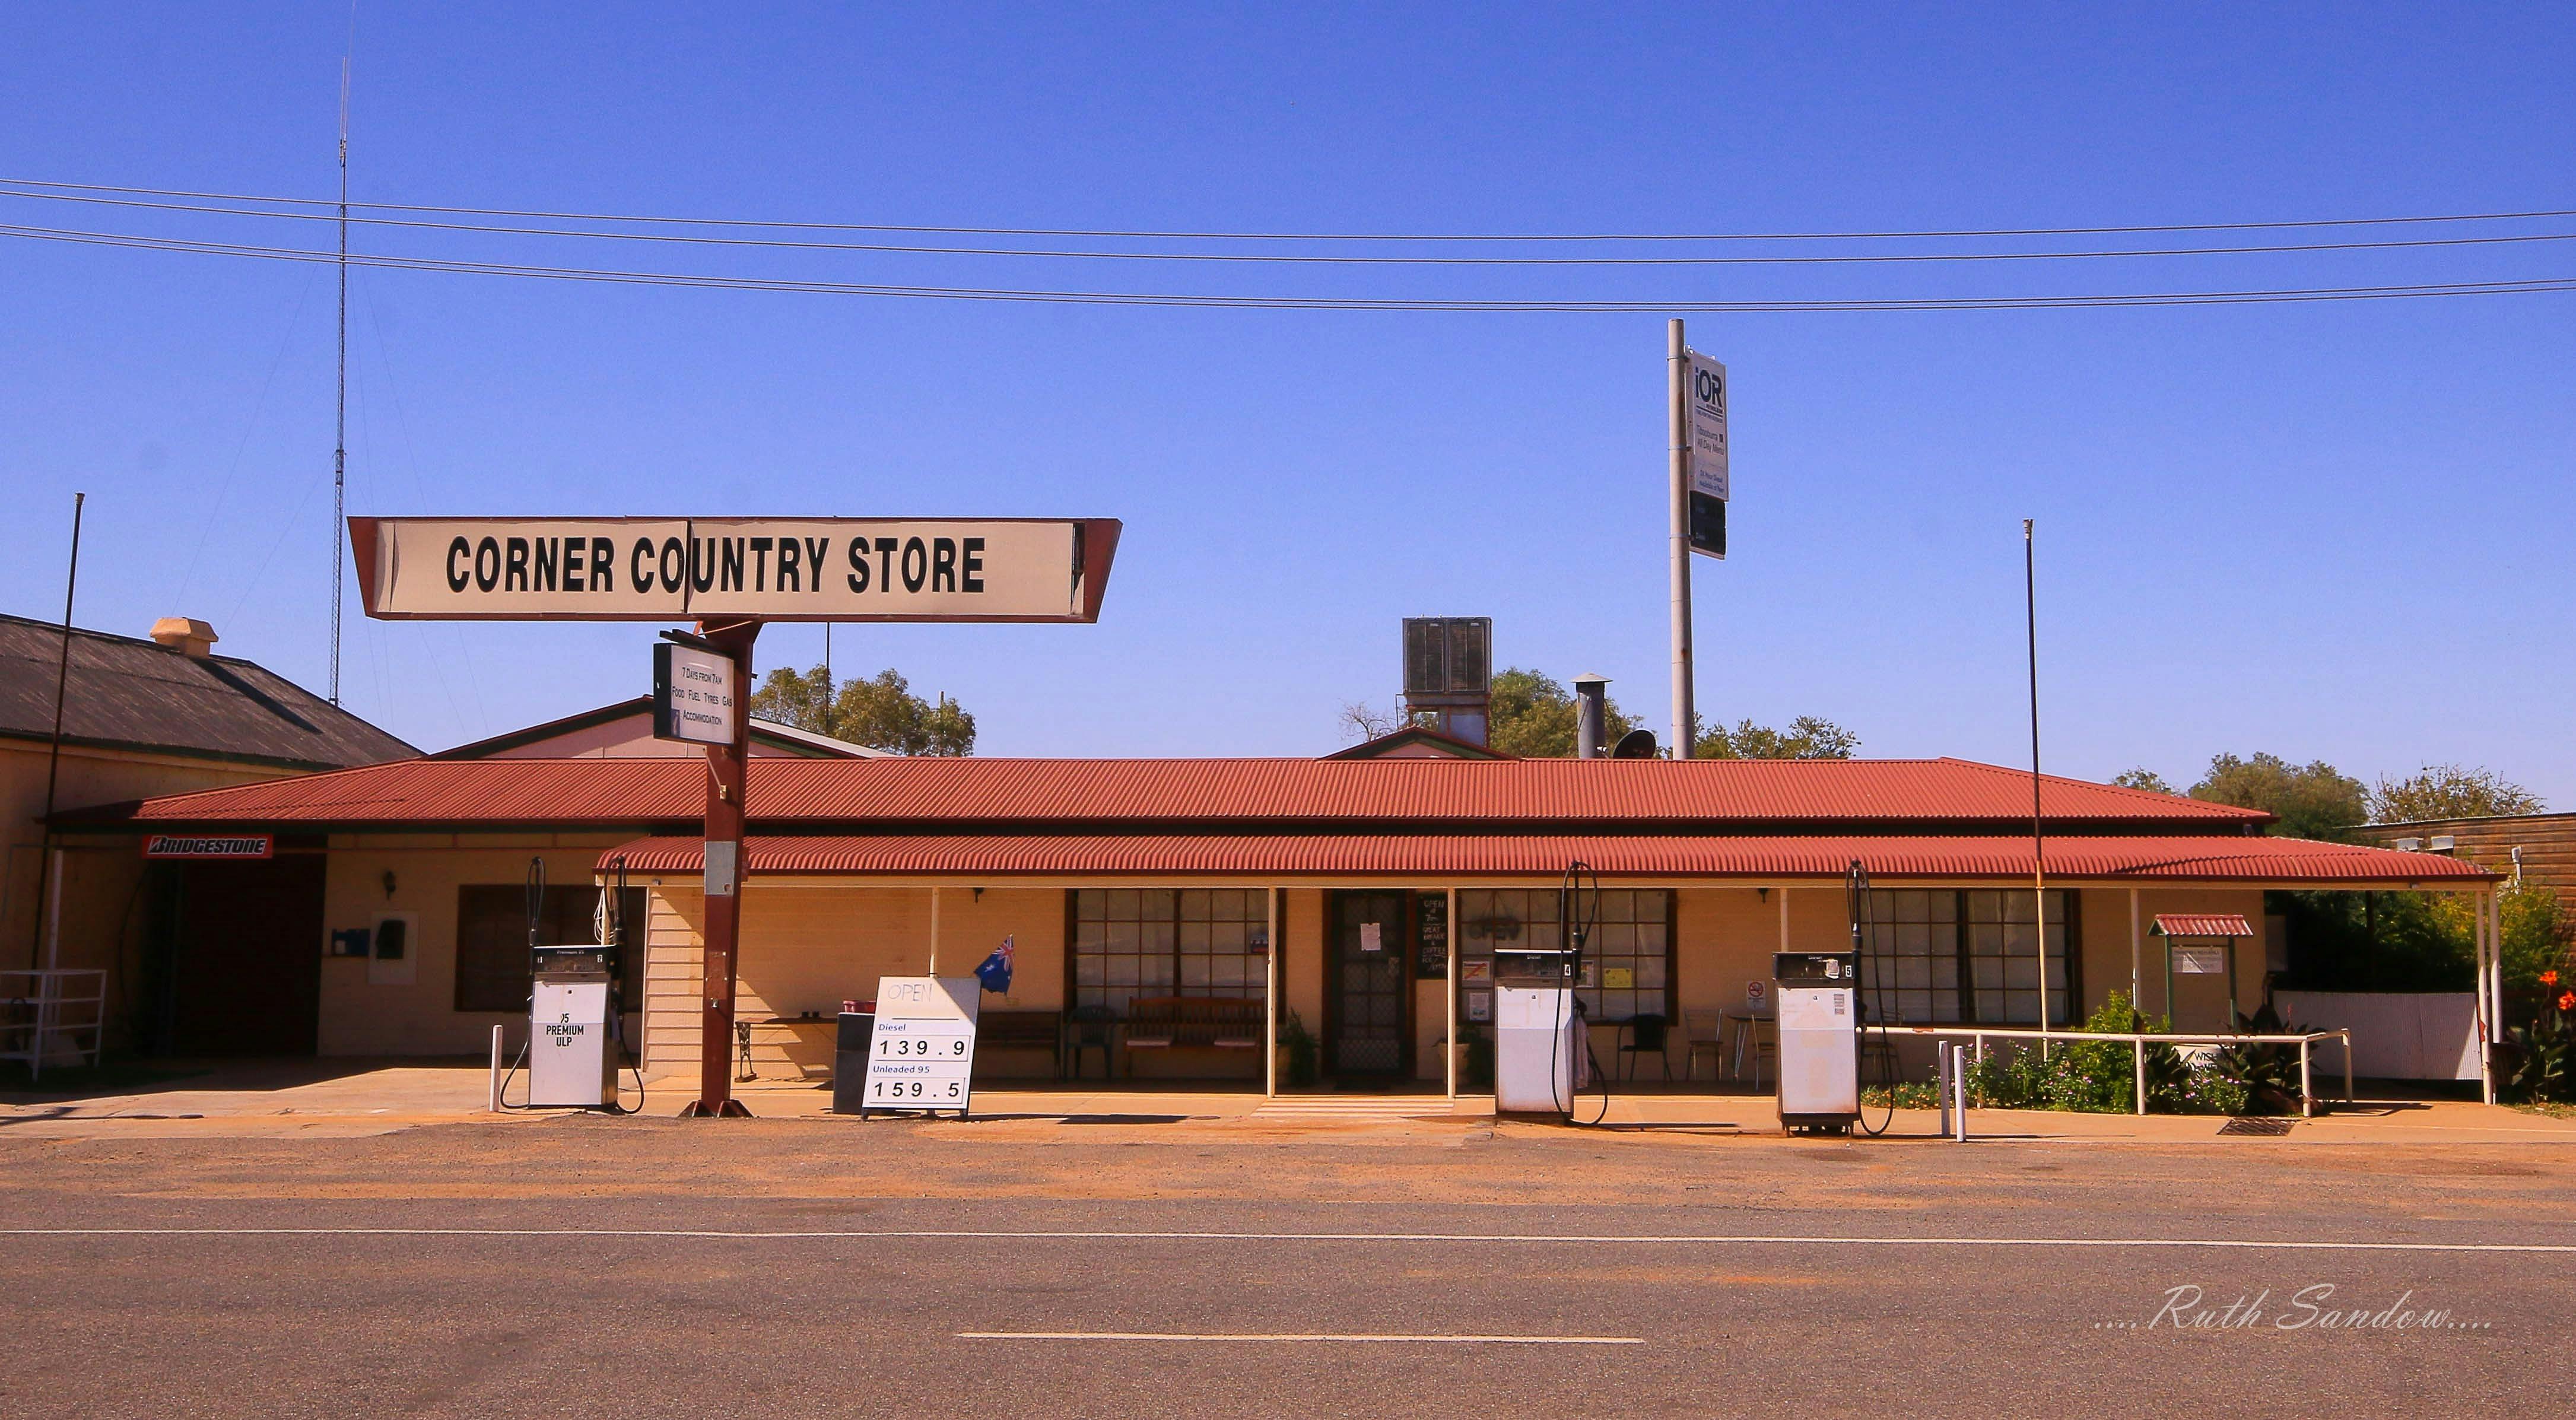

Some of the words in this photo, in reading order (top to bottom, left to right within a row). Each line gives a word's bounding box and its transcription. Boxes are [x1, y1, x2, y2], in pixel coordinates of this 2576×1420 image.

[446, 535, 615, 593] CORNER
[631, 535, 830, 593] COUNTRY
[847, 536, 985, 593] STORE
[682, 667, 686, 677] 7
[148, 836, 267, 854] BRIDGESTONE
[1846, 967, 1851, 976] 5
[888, 983, 932, 1002] OPEN
[546, 1025, 585, 1035] PREMIUM
[556, 1037, 572, 1047] ULP
[873, 1065, 915, 1073] Unleaded
